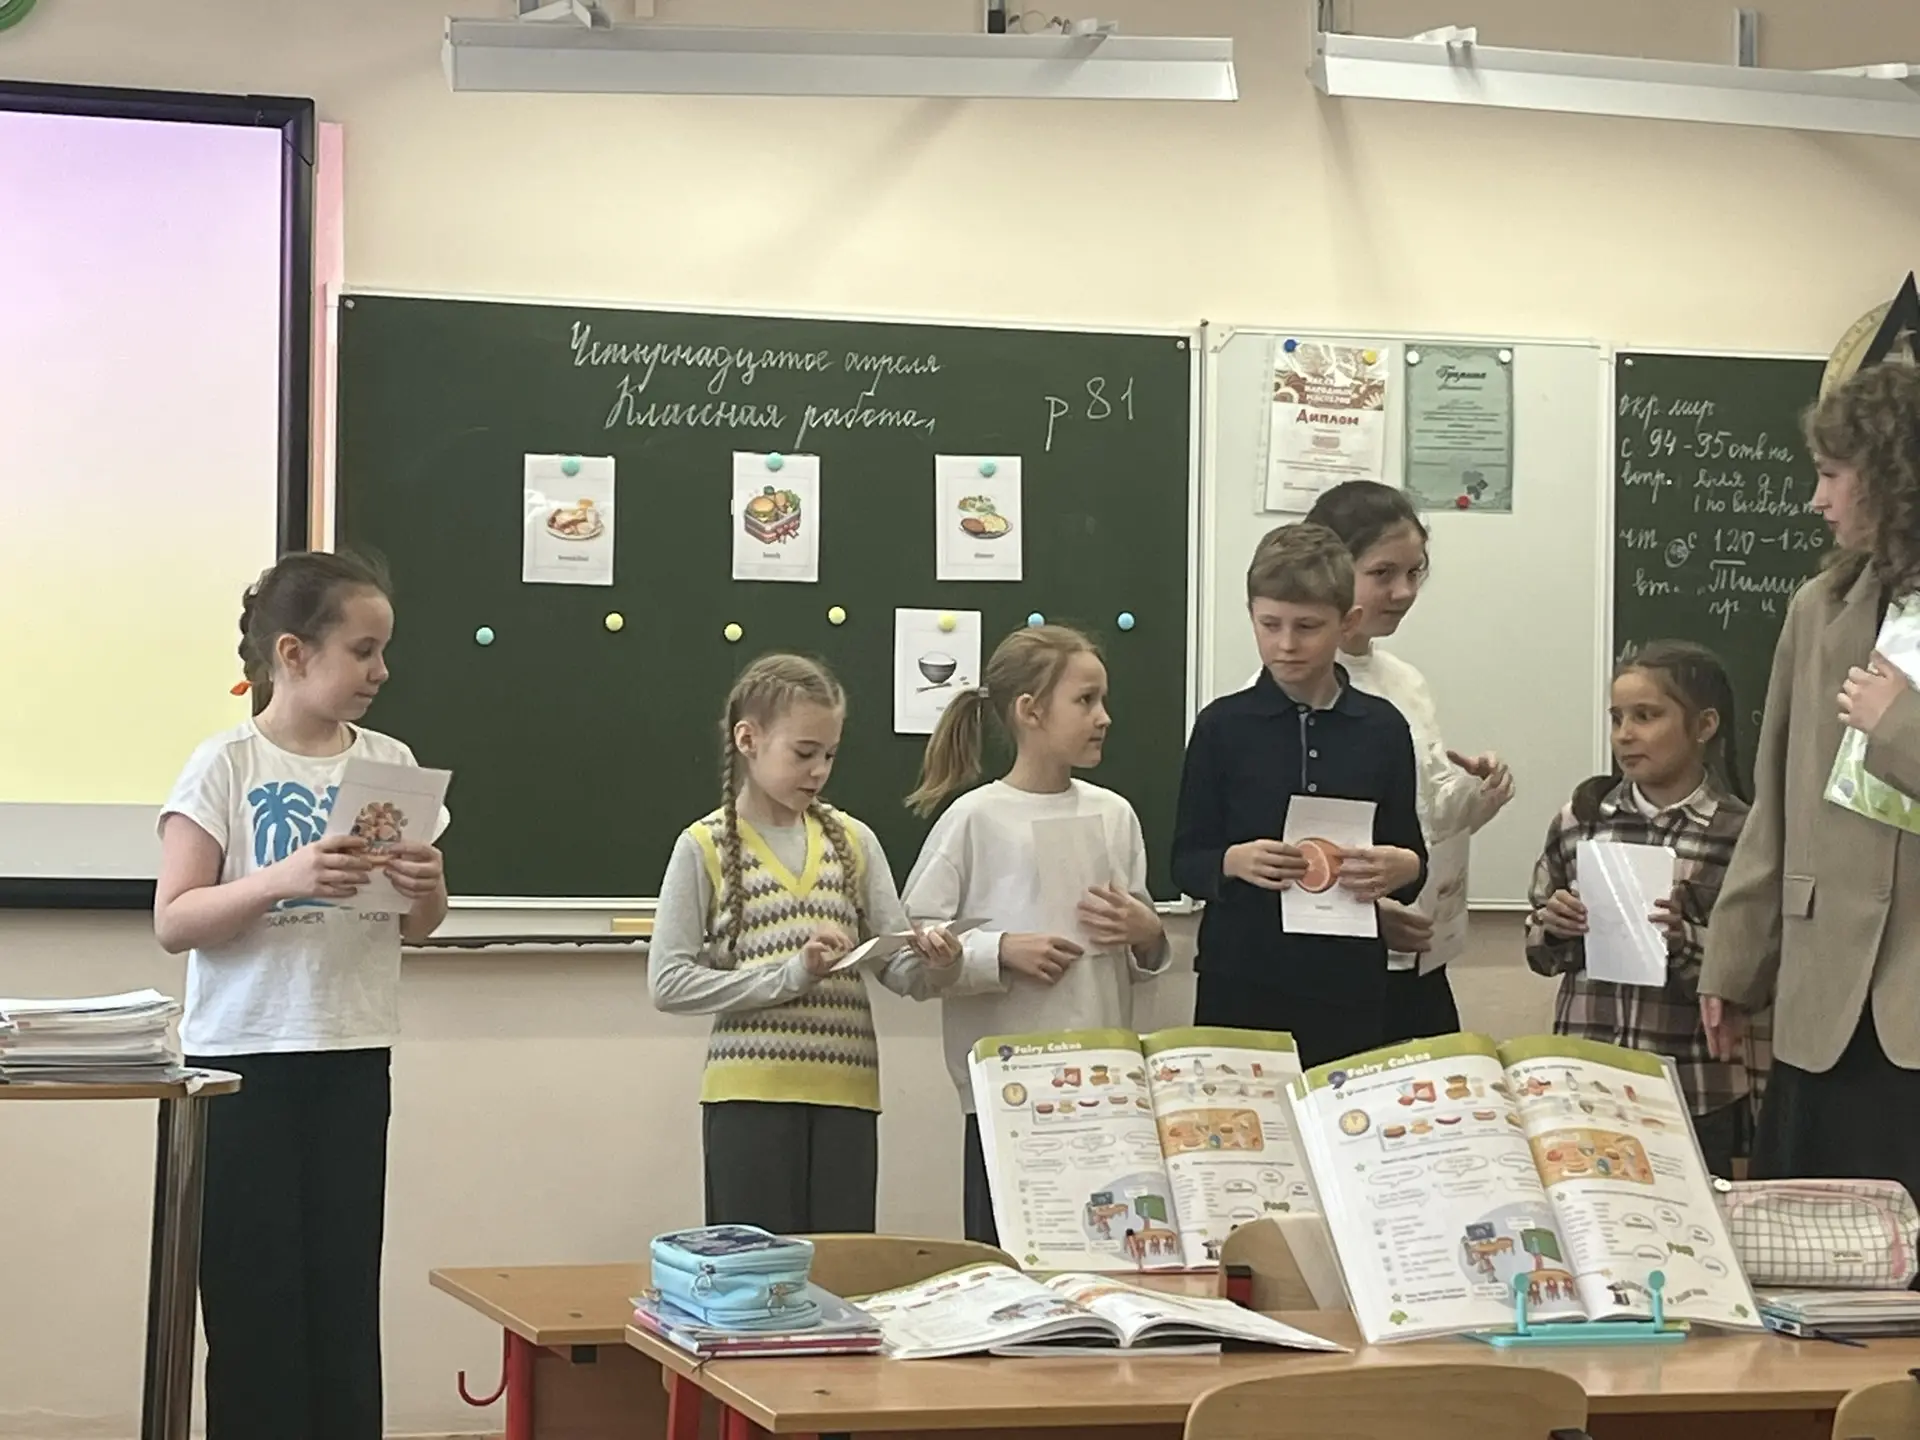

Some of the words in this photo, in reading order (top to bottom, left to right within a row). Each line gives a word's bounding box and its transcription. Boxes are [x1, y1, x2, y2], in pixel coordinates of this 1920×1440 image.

[571, 320, 833, 395] Четырнадцатое
[604, 373, 788, 429] Классная
[1086, 377, 1134, 420] 81
[1346, 1062, 1385, 1078] Fairy
[1387, 1052, 1431, 1068] Cakes
